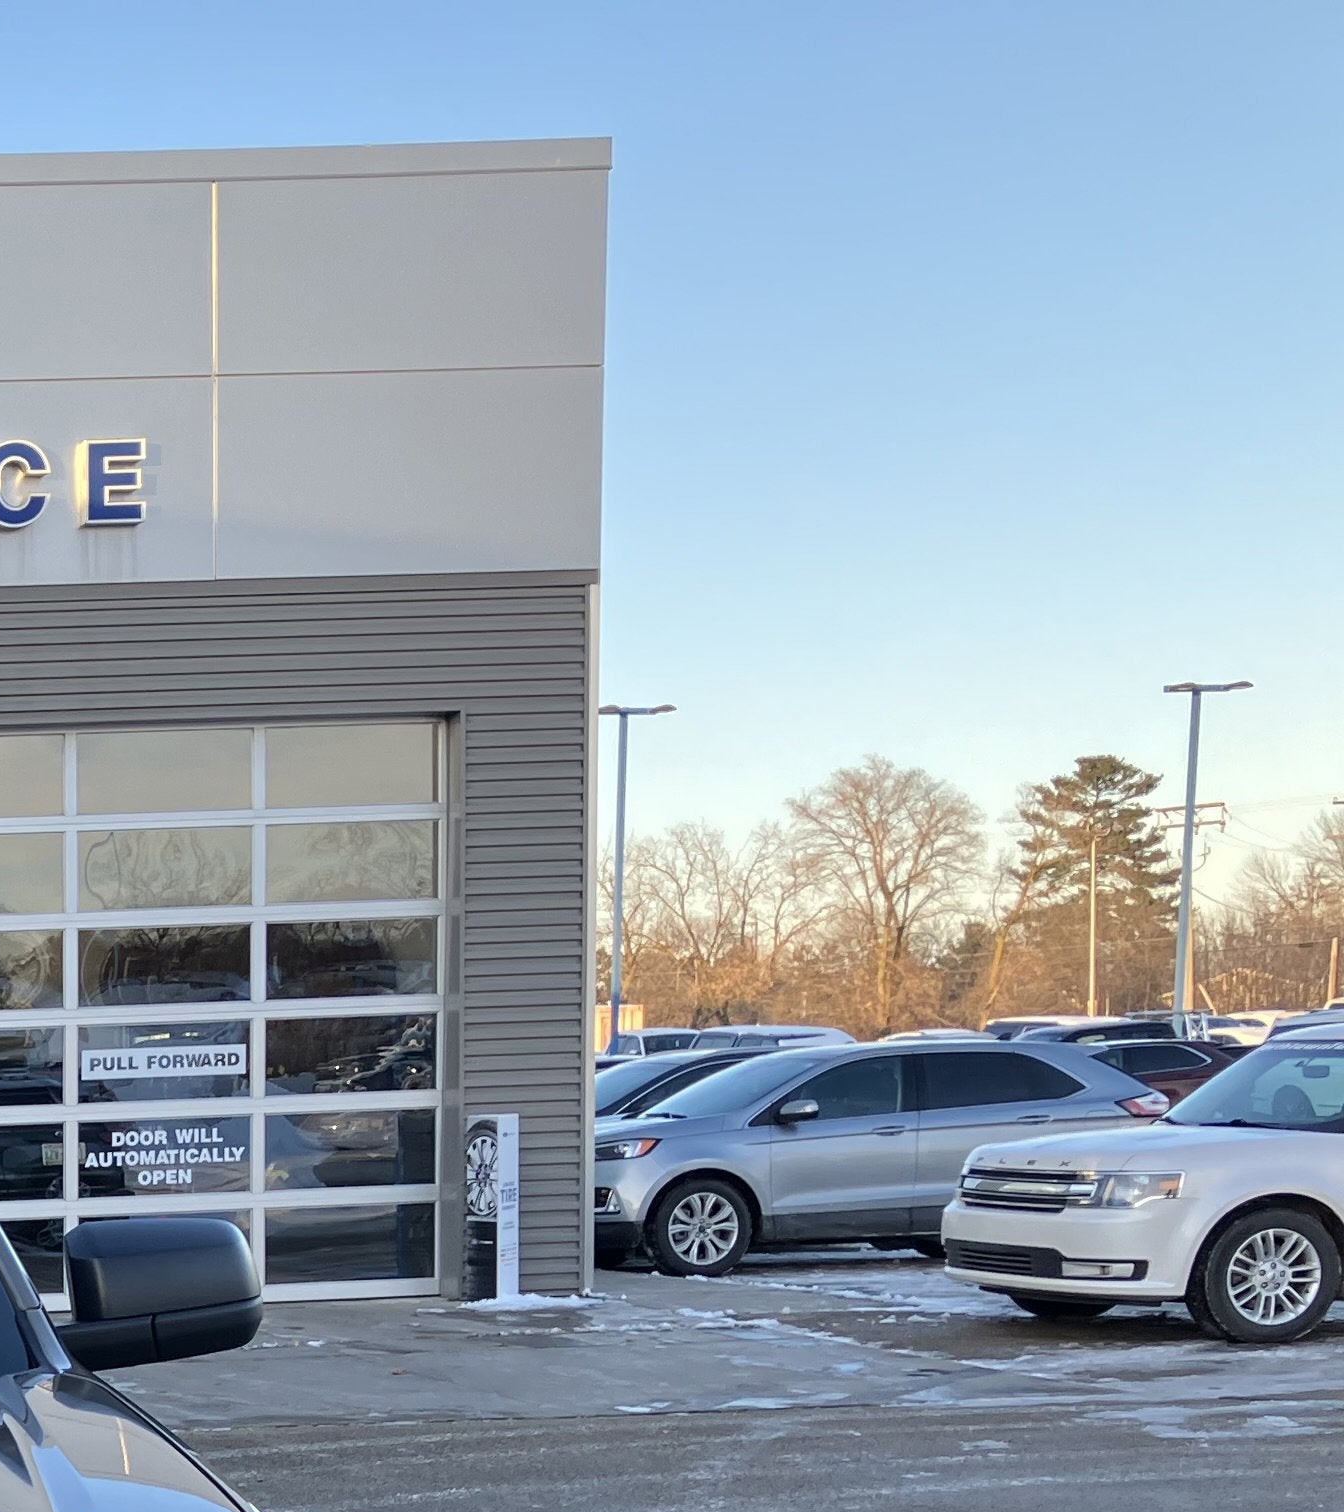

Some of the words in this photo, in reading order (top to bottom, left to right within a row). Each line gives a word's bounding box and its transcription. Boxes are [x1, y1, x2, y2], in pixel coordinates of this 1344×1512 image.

[89, 1056, 139, 1072] PULL
[146, 1052, 240, 1070] FORWARD
[111, 1130, 168, 1147] DOOR
[175, 1127, 224, 1144] WILL
[84, 1146, 246, 1168] AUTOMATICALLY
[137, 1168, 192, 1185] OPEN
